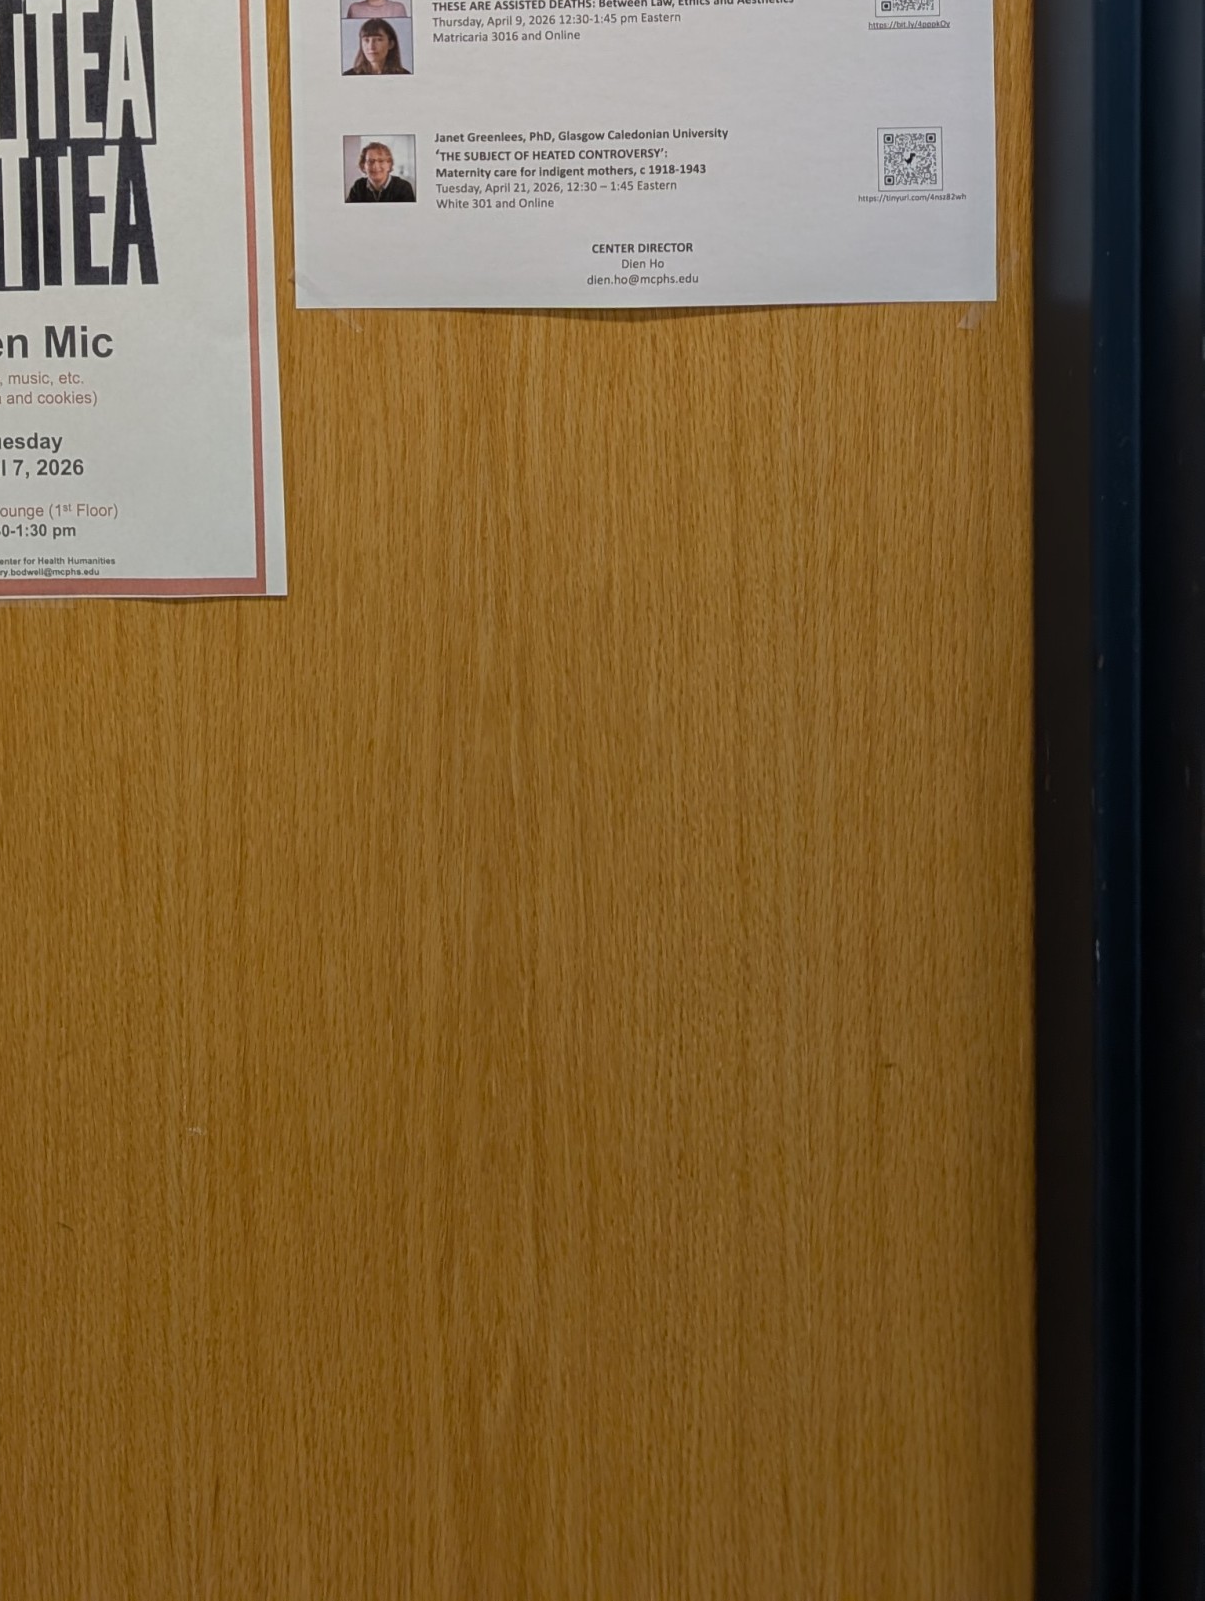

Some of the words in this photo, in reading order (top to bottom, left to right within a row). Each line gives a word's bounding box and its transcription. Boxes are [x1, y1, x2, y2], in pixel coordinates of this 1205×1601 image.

[435, 133, 464, 142] Janet
[467, 132, 526, 143] Greenlees,
[530, 132, 555, 142] PhD,
[558, 131, 605, 142] Glasgow
[608, 130, 669, 140] Caledonian
[673, 128, 728, 139] University
[592, 244, 634, 253] CENTER
[638, 243, 693, 253] DIRECTOR
[622, 259, 646, 269] Dien
[650, 259, 664, 268] Ho
[45, 326, 113, 358] Mic
[8, 372, 53, 386] music,
[59, 372, 83, 384] etc.
[7, 392, 32, 404] and
[37, 391, 97, 406] cookies)
[13, 460, 29, 478] 7,
[37, 459, 83, 475] 2026
[77, 504, 118, 519] Floor)
[53, 527, 76, 539] pm
